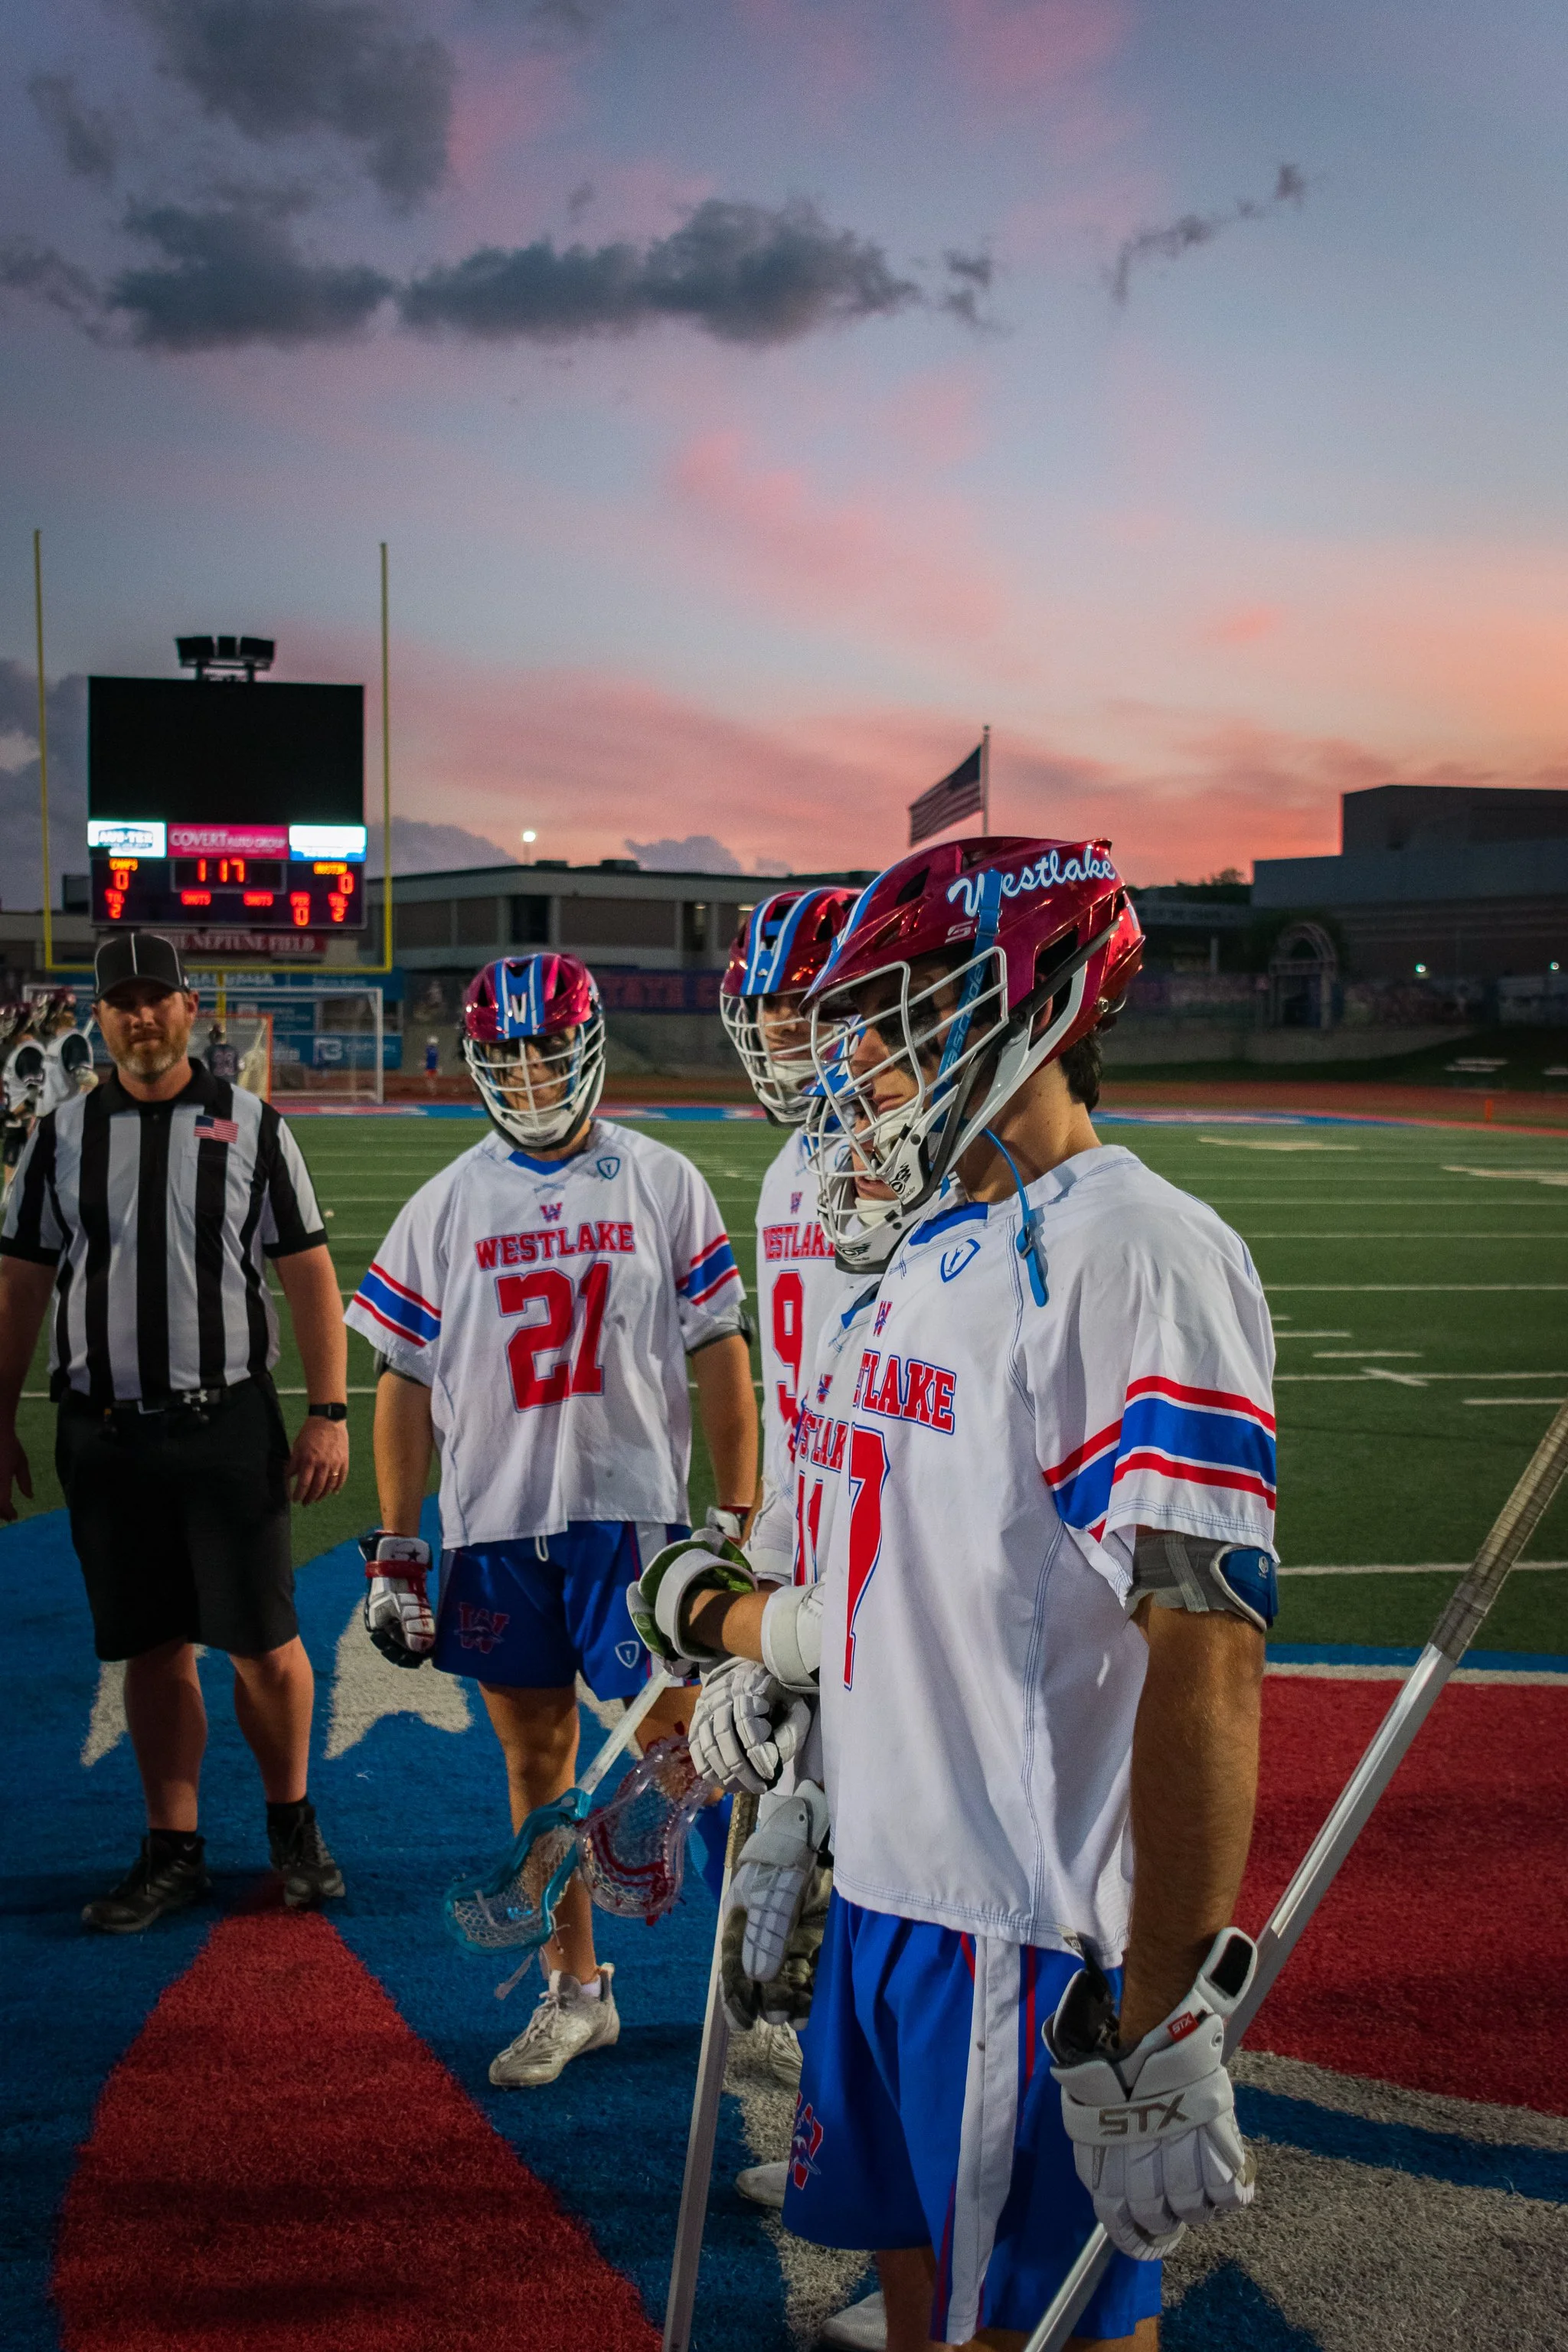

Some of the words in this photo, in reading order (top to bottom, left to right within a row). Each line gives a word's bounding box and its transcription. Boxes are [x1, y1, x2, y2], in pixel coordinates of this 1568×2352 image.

[170, 829, 227, 847] COVERT
[946, 850, 1116, 916] Westlake
[475, 1220, 635, 1272] WESTLAKE
[494, 1259, 612, 1414] 21
[1172, 2014, 1193, 2034] STX
[1099, 2092, 1190, 2136] STX
